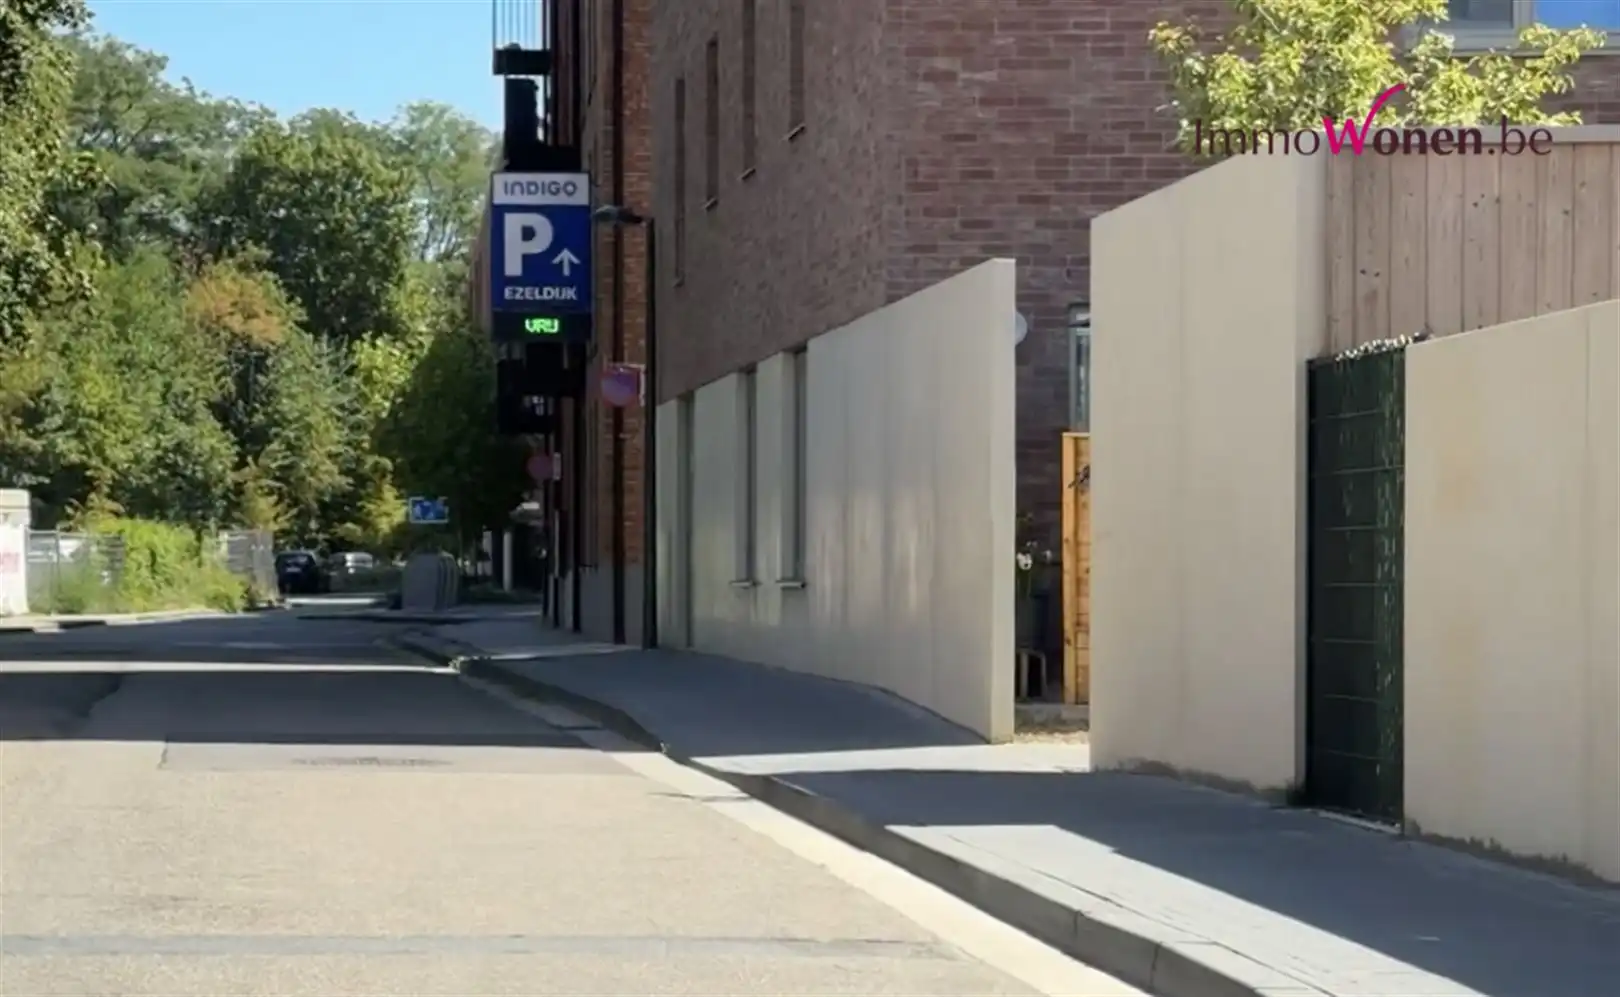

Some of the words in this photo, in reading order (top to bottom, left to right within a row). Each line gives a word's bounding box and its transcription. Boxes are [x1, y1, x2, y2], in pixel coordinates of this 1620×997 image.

[504, 181, 578, 197] INDIGO
[504, 212, 554, 276] P
[504, 286, 578, 301] EZELDIJK
